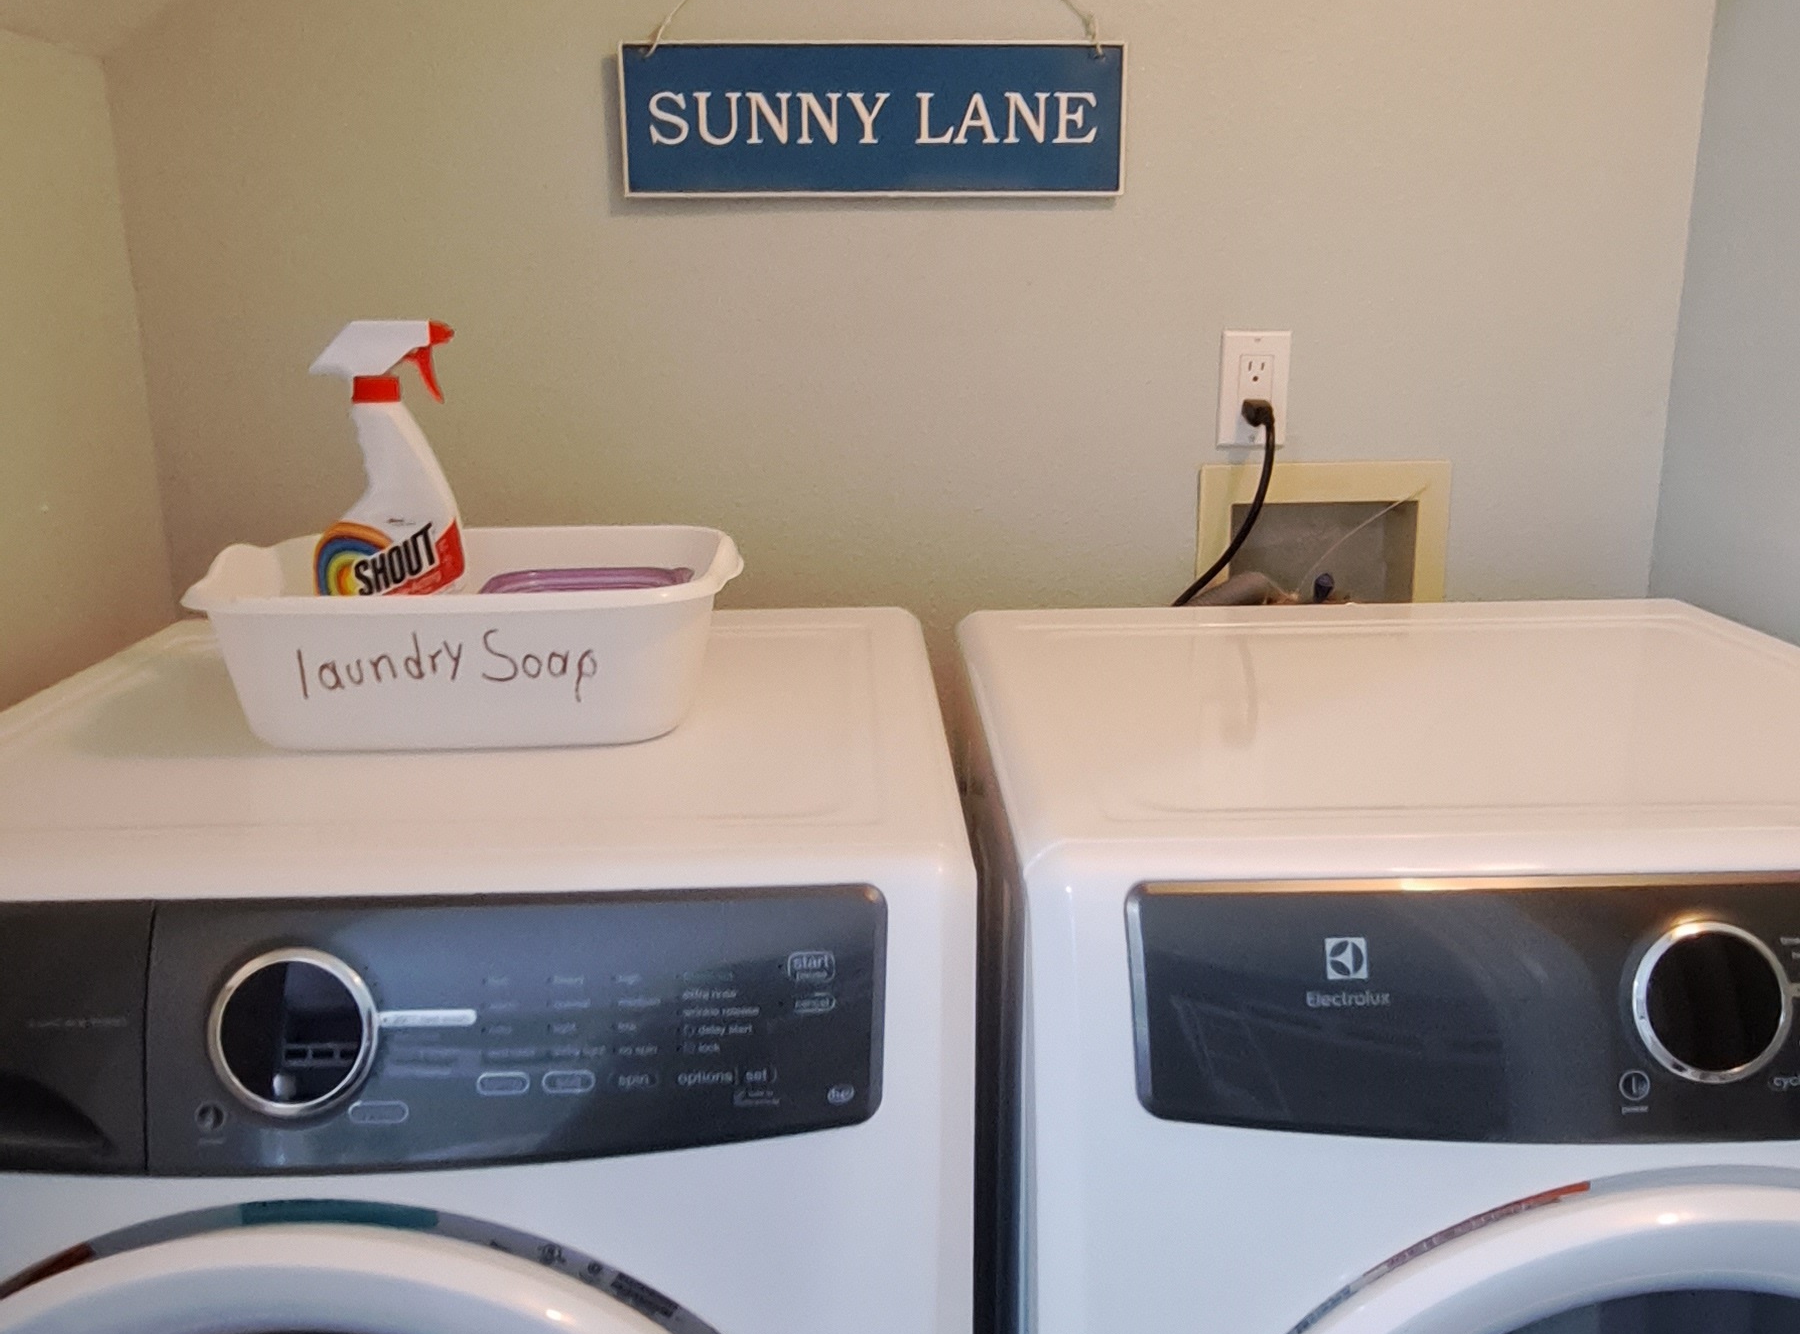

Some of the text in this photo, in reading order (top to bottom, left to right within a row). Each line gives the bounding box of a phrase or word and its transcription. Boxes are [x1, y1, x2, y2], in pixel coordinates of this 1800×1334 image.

[648, 90, 1099, 146] SUNNY LANE
[354, 521, 436, 596] SHOUT
[296, 628, 598, 703] laundry Soap
[1305, 989, 1391, 1008] Electrolux
[677, 1069, 734, 1088] options
[744, 1068, 769, 1083] set
